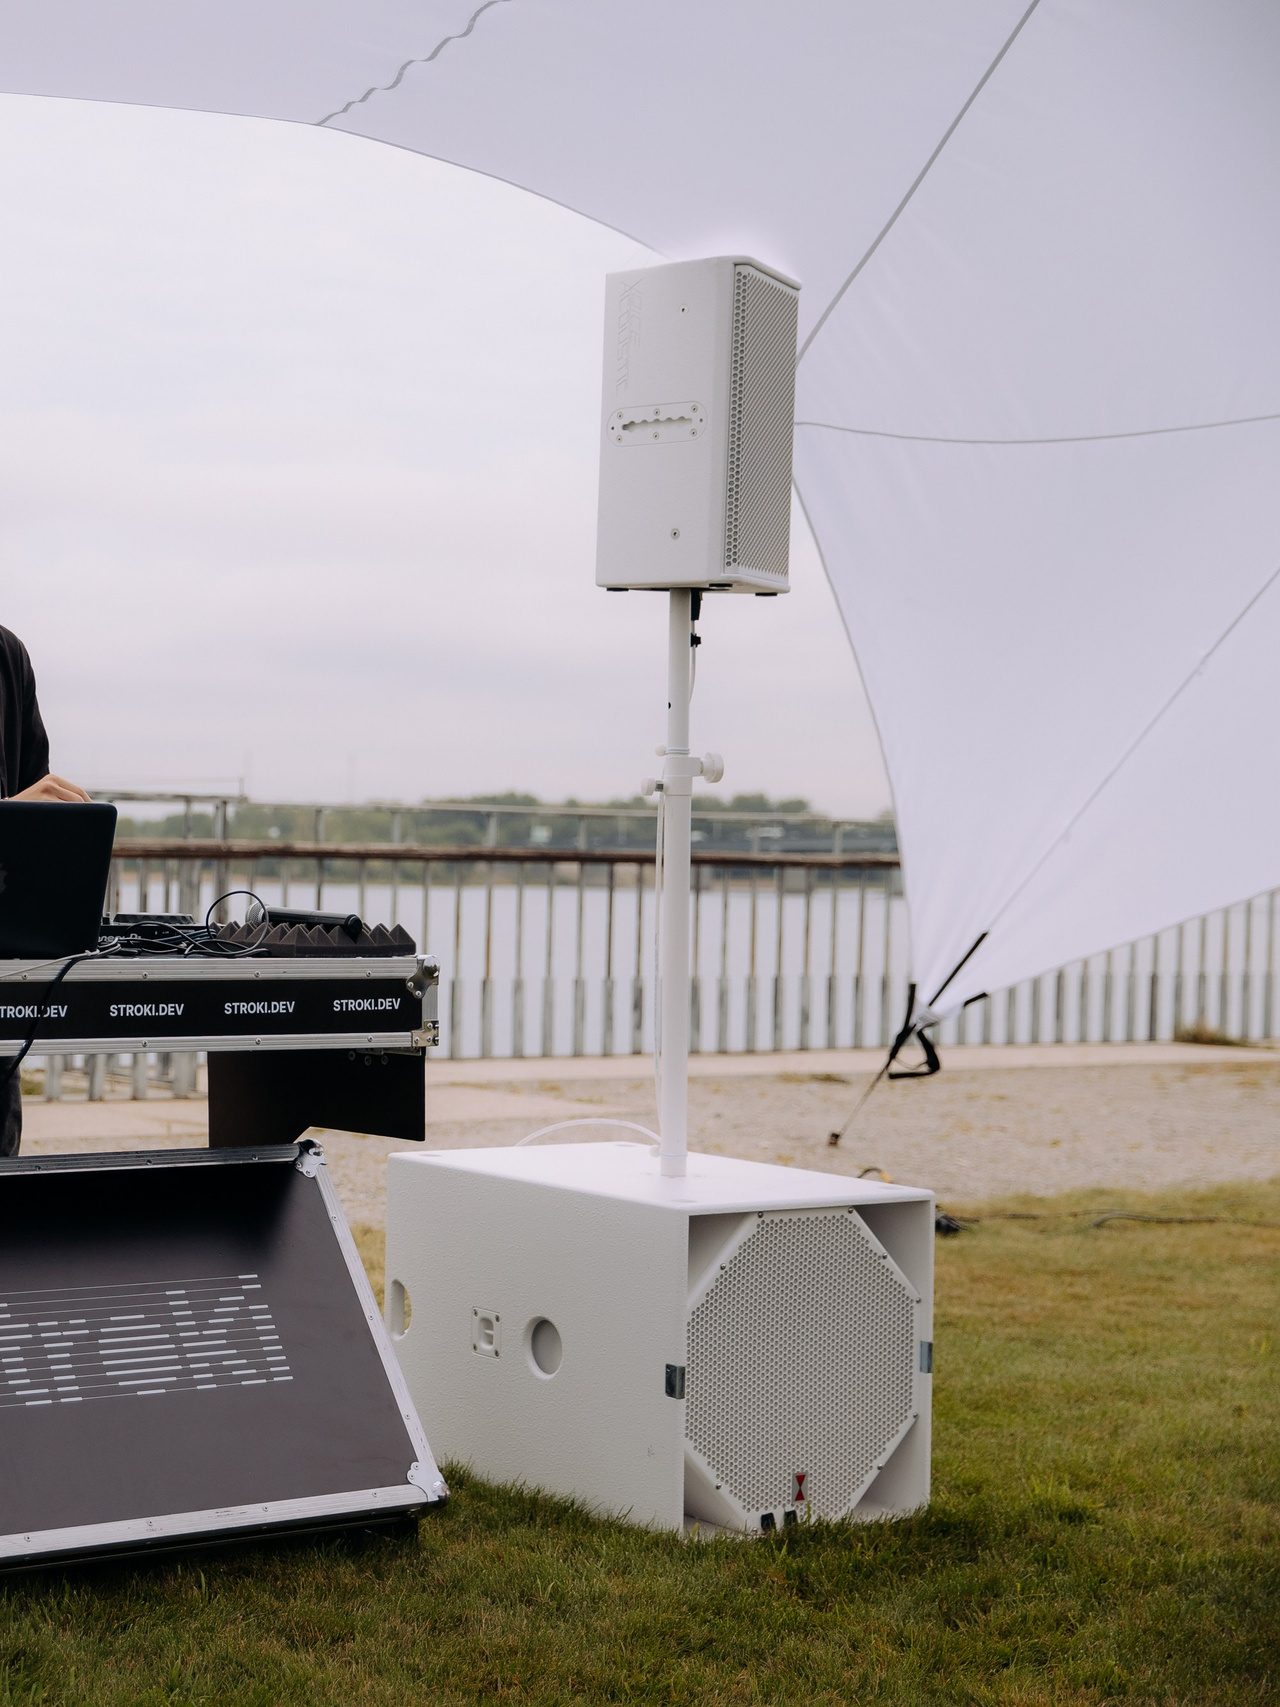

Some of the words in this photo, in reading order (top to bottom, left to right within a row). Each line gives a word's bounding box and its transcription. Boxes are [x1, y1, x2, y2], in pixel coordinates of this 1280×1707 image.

[109, 1003, 185, 1017] STROKI.DEV
[224, 1001, 296, 1015] STROKI.DEV
[333, 998, 401, 1012] STROKI.DEV
